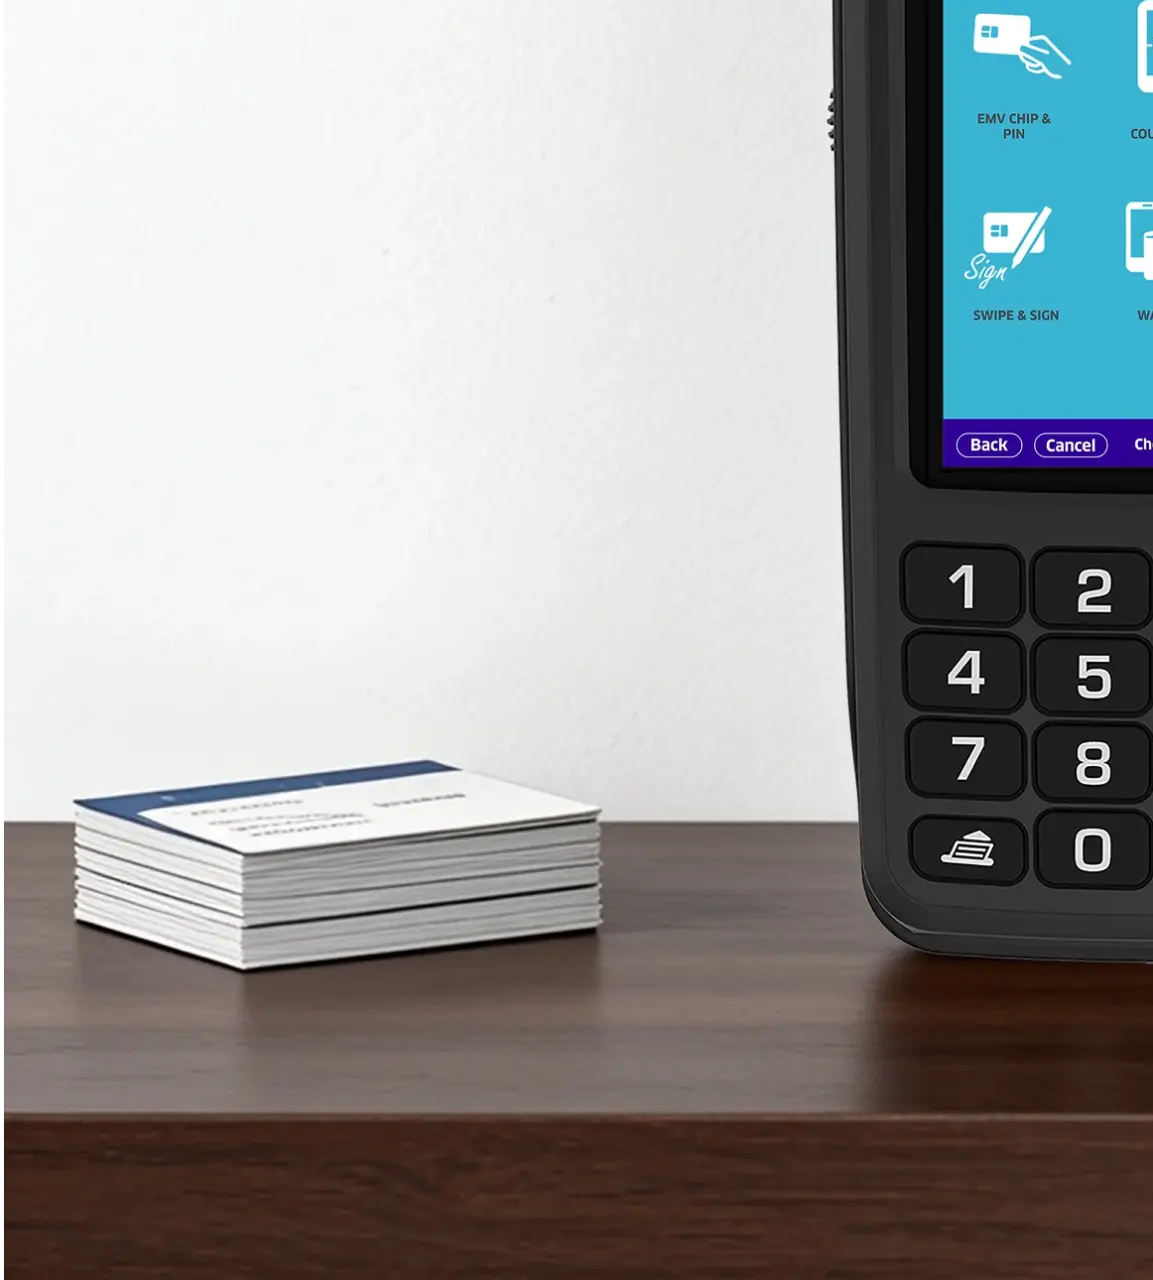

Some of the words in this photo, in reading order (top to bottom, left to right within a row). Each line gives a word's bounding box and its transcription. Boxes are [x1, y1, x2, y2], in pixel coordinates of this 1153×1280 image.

[978, 114, 1005, 123] EMV
[1009, 114, 1038, 124] CHIP
[1042, 113, 1051, 124] &
[1004, 129, 1024, 139] PIN
[964, 253, 1007, 289] Sign
[974, 310, 1013, 320] SWIPE
[1018, 310, 1026, 320] &
[1030, 310, 1060, 320] SIGN
[971, 438, 1007, 451] Back
[1047, 439, 1095, 452] Cancel
[949, 565, 973, 608] 1
[1078, 569, 1111, 612] 2
[948, 651, 985, 694] 4
[1078, 655, 1111, 698] 5
[952, 737, 984, 780] 7
[1076, 742, 1110, 785] 8
[1075, 828, 1111, 872] 0
